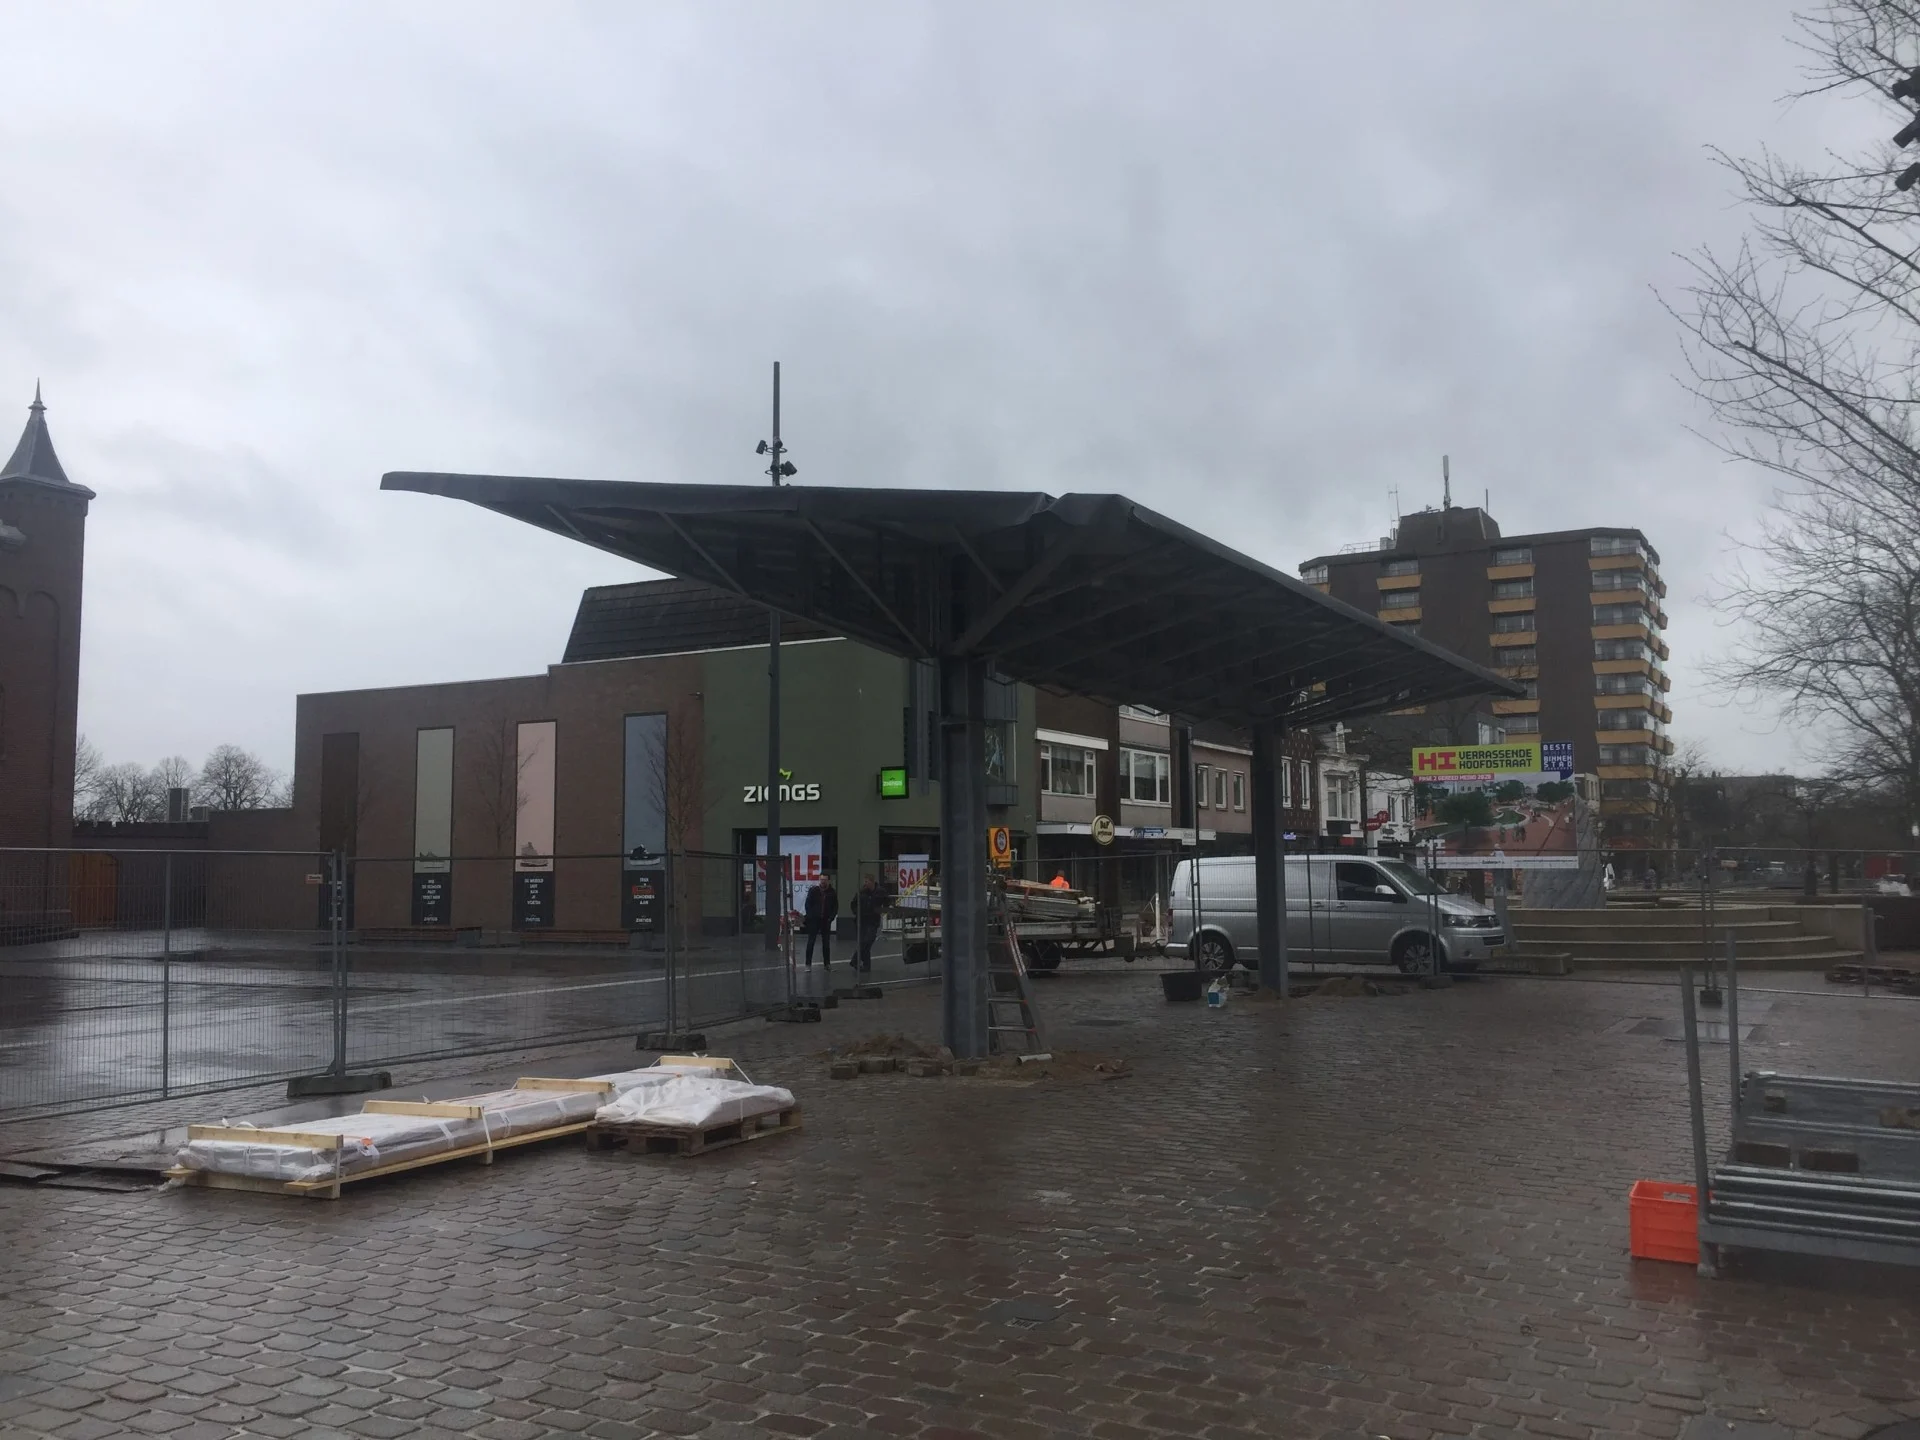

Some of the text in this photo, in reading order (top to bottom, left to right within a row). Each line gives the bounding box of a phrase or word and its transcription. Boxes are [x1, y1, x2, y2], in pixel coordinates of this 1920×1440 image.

[1543, 743, 1572, 751] BESTE
[1459, 749, 1532, 760] VERRASSENDE
[1418, 752, 1457, 771] HI
[1459, 759, 1533, 769] HOOFDSTRAAT
[758, 855, 821, 881] SLE
